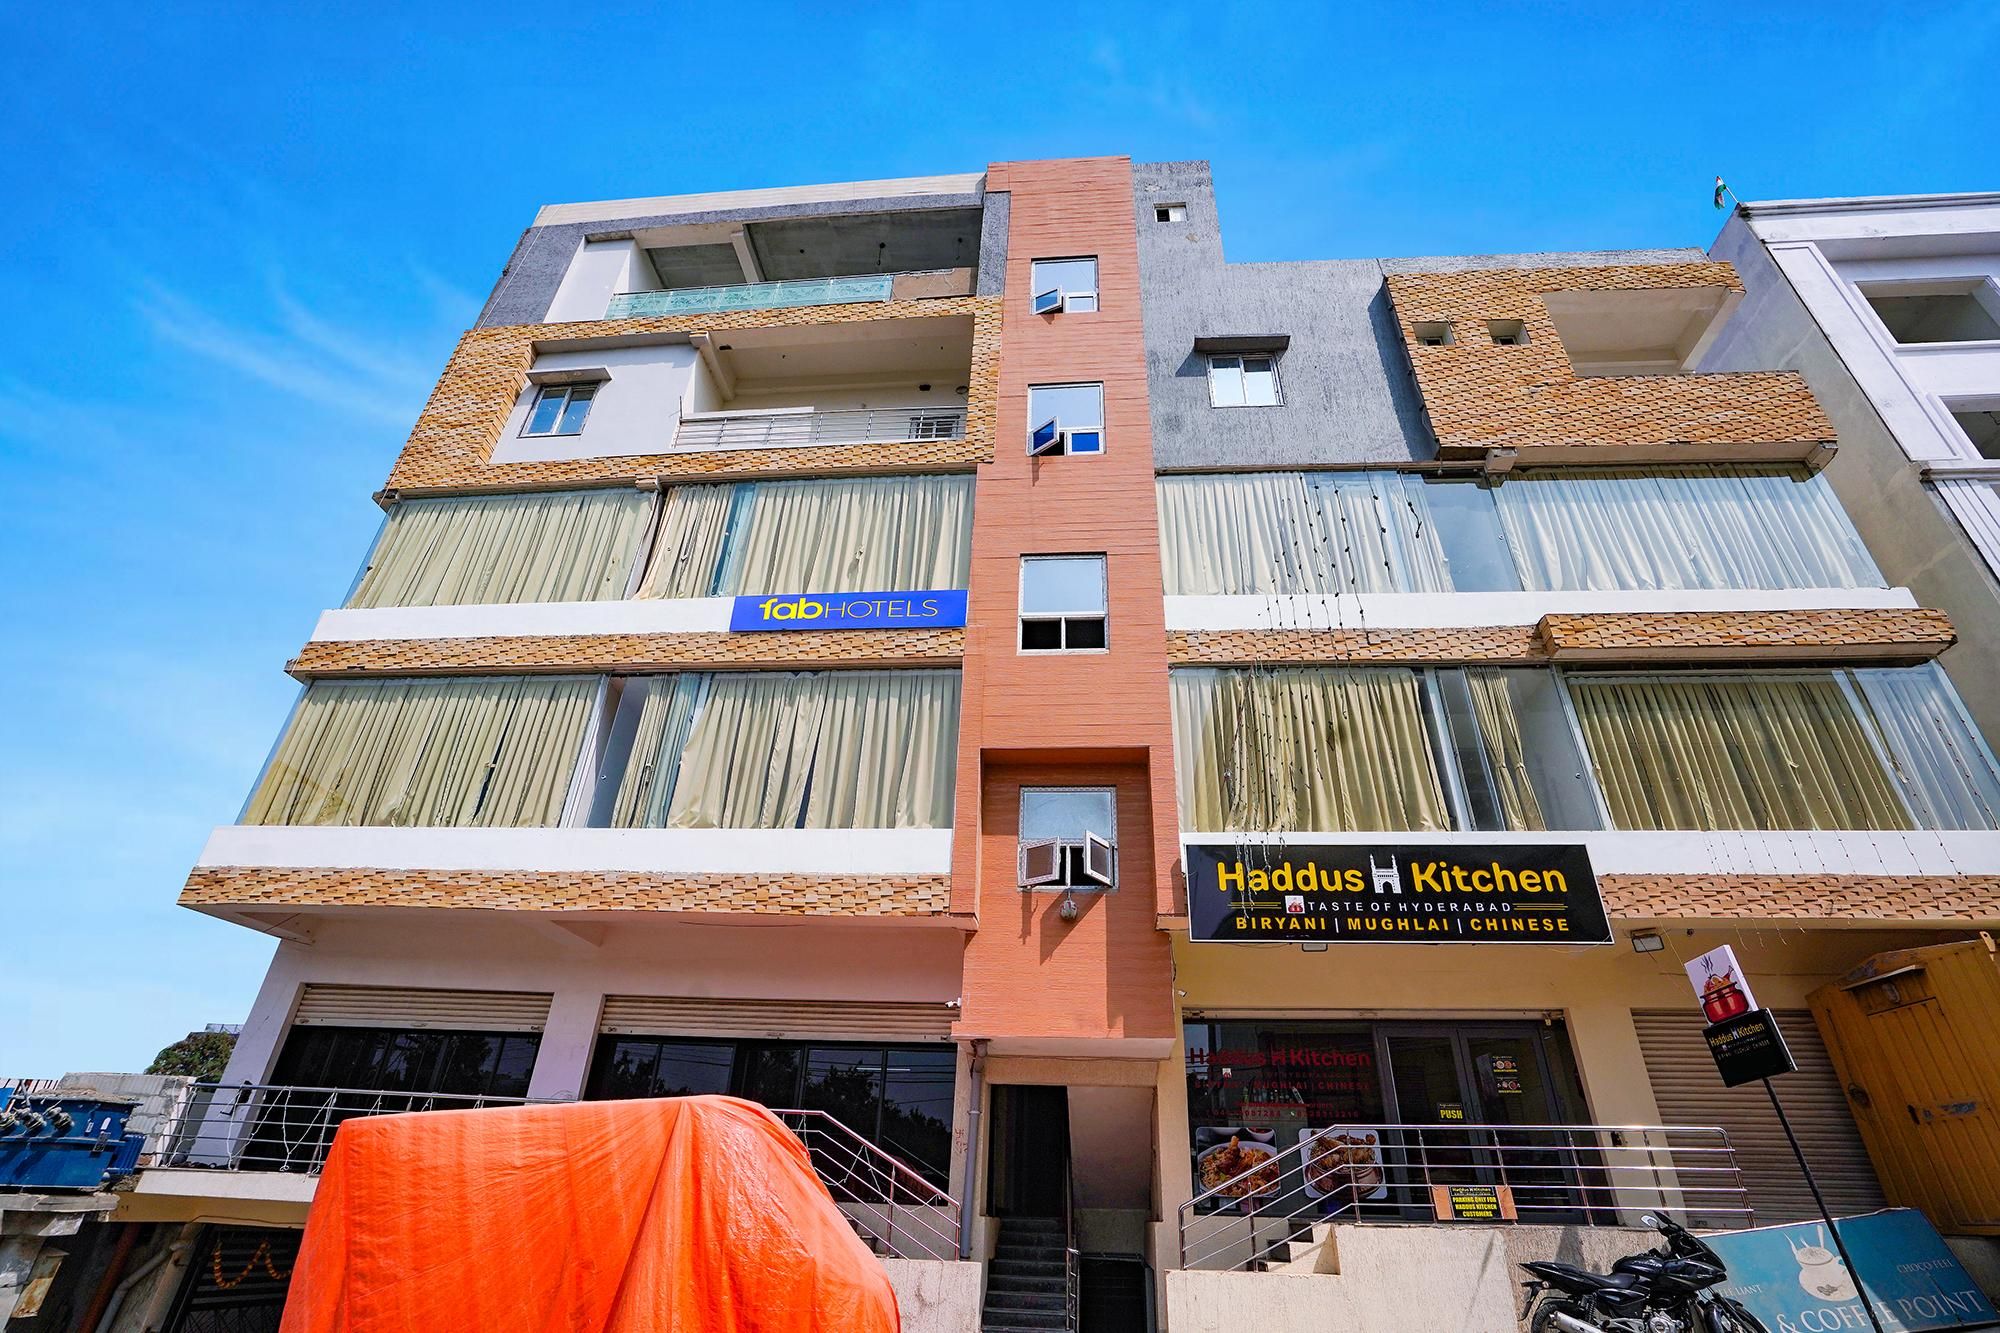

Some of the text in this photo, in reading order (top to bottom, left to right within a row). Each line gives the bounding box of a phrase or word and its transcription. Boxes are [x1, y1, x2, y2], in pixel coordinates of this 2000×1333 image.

[1217, 862, 1568, 893] Haddus Kitchen
[1308, 901, 1512, 913] TASTE OF HYDERABAD
[1236, 917, 1570, 932] BIRYANI MUGHLAI CHINESE
[1737, 1022, 1765, 1038] Kitchen
[1289, 1047, 1371, 1067] Kitchen
[1440, 1109, 1463, 1119] PUSH
[1896, 1261, 1932, 1273] CHOCO
[1776, 1313, 1802, 1333] &
[1896, 1290, 1985, 1321] POINT
